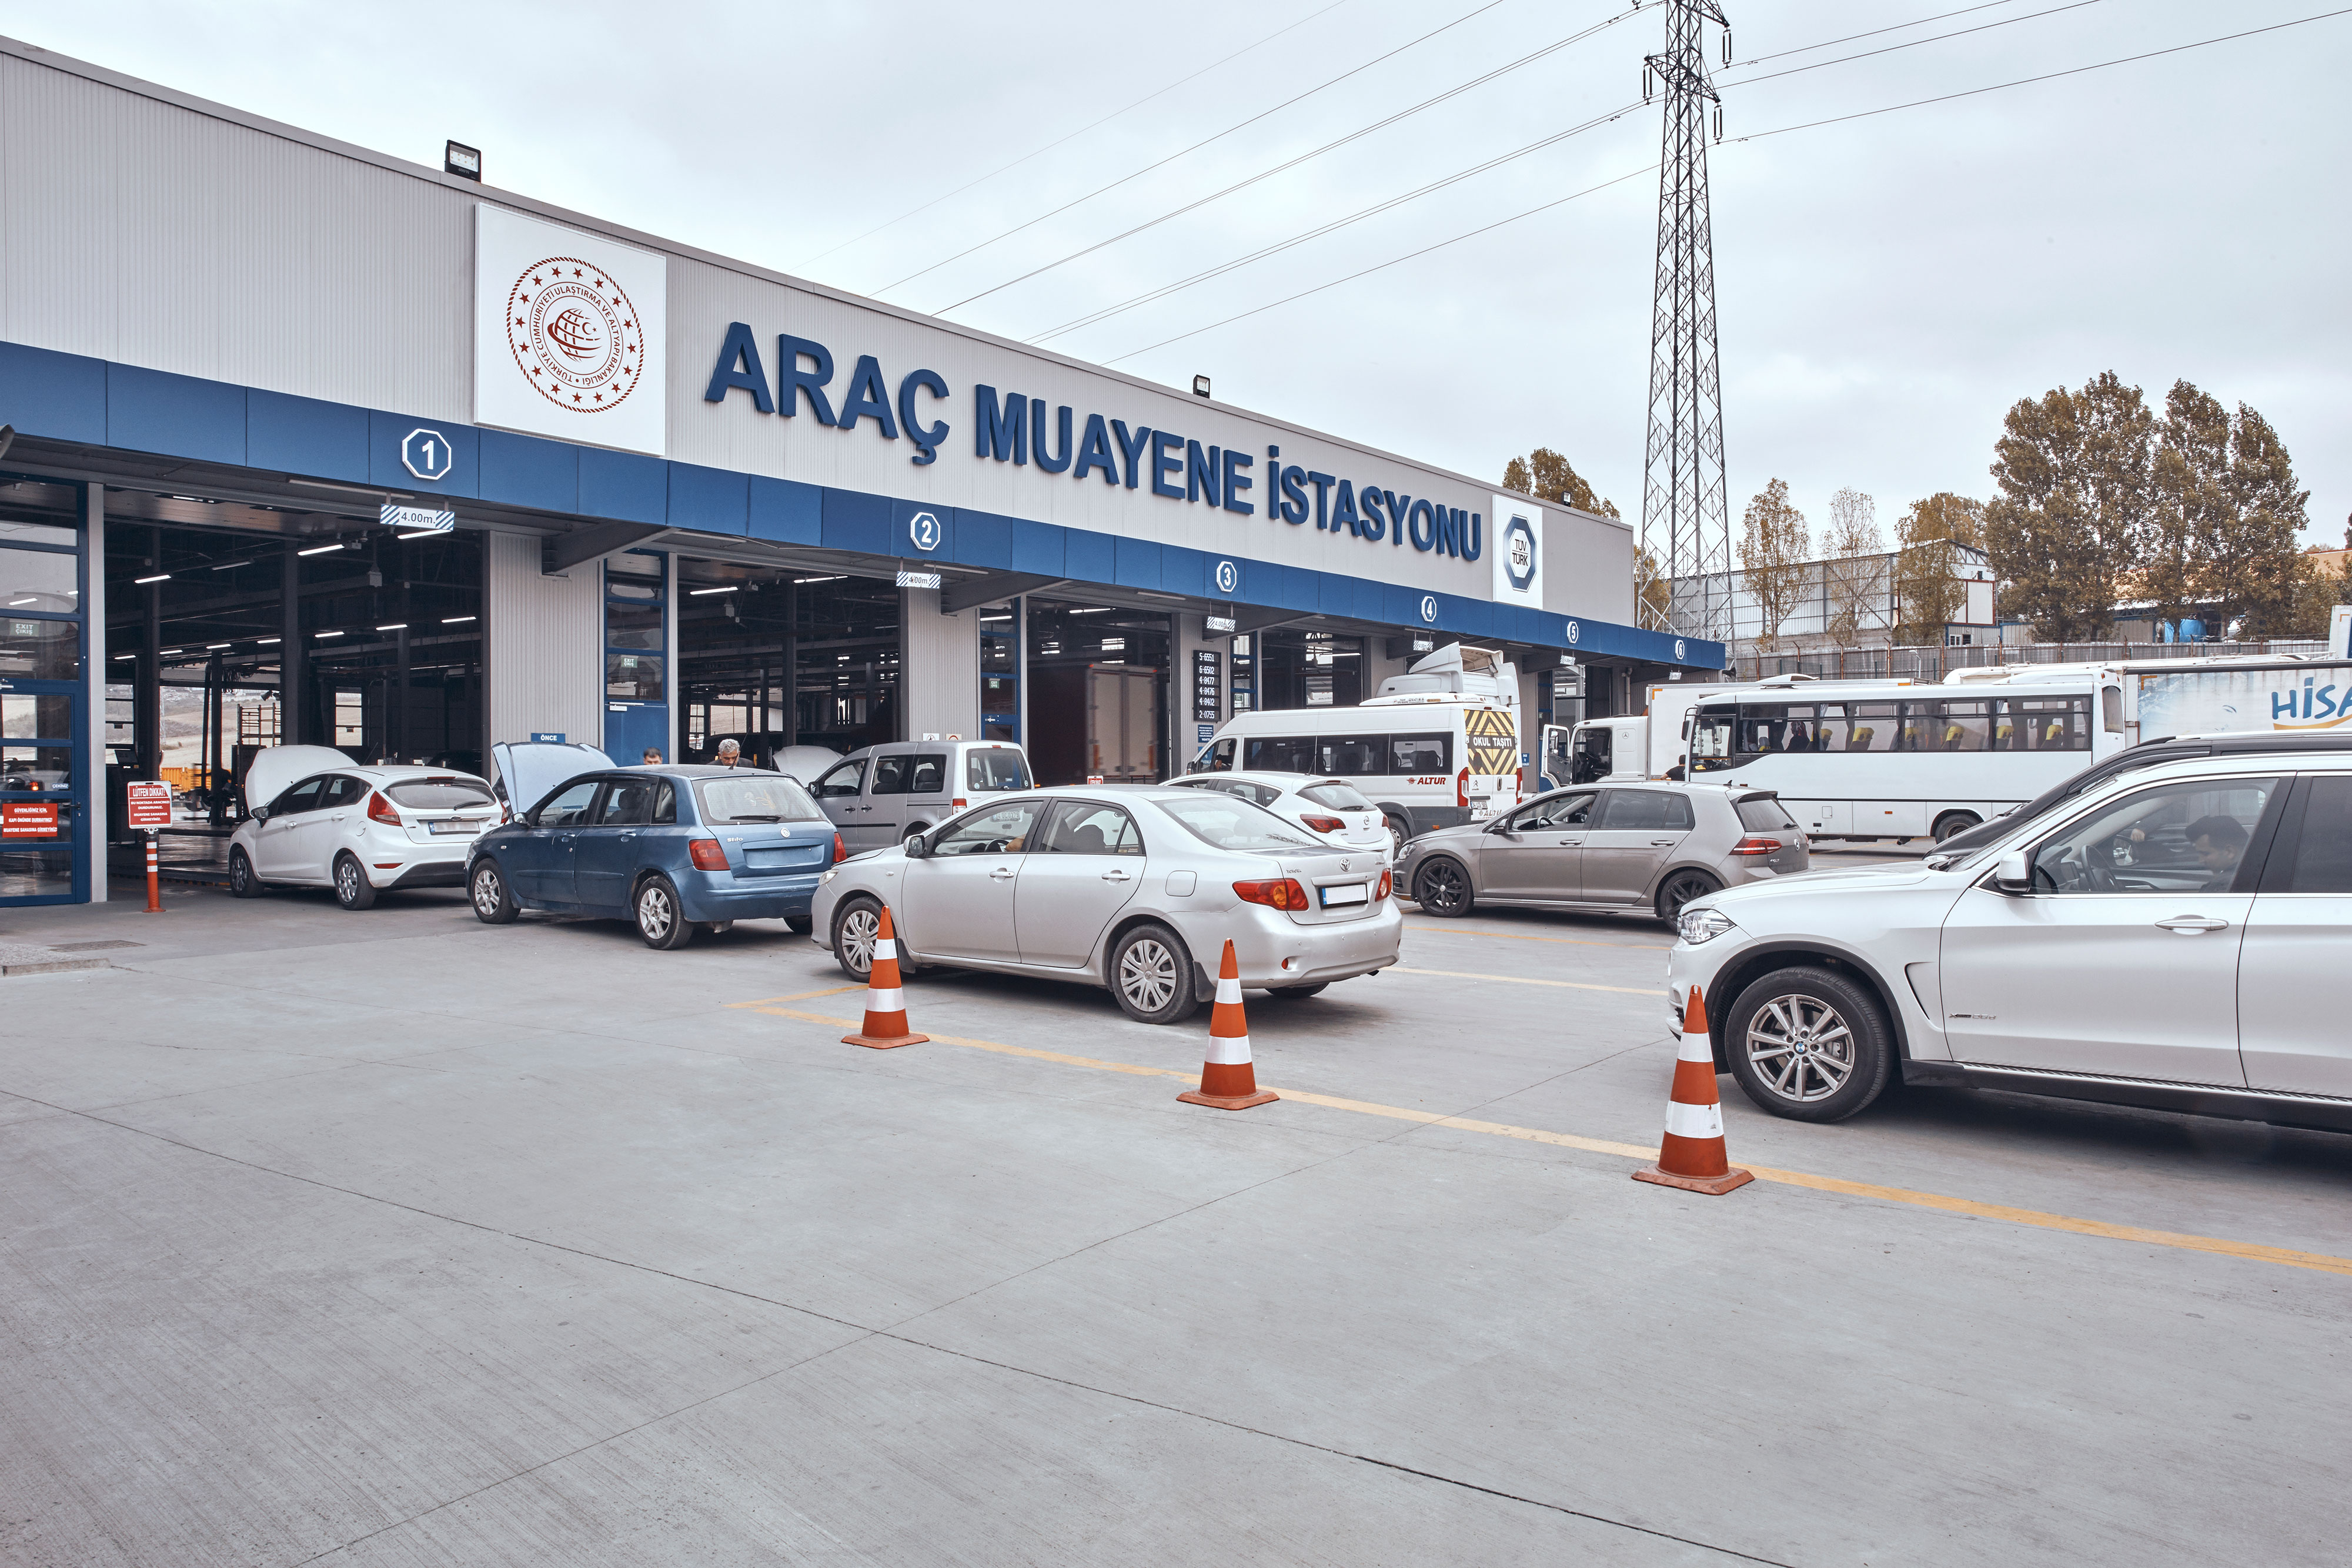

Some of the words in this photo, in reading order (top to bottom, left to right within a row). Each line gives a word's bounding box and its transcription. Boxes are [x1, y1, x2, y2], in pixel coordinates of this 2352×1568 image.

[554, 286, 601, 307] ULAŞTIRMA
[602, 305, 612, 318] VE
[533, 289, 554, 350] CUMHURİYETİ
[609, 319, 620, 356] ALTYAPI
[540, 351, 572, 382] TÜRKİYE
[582, 356, 617, 386] BAKANLIĞI
[704, 322, 950, 465] ARAÇ
[975, 384, 1254, 515] MUAYENE
[1268, 445, 1481, 561] İSTASYONU
[422, 440, 434, 470] 1
[401, 511, 436, 524] 4.00m.
[921, 520, 932, 543] 2
[1515, 539, 1527, 551] TÜV
[1512, 552, 1528, 567] TÜRK
[1224, 567, 1231, 586] 3
[1426, 601, 1433, 617] 4
[1571, 626, 1576, 640] 5
[1679, 643, 1683, 656] 6
[1199, 653, 1215, 662] 5-6551
[1199, 676, 1215, 685] 4-8477
[1199, 710, 1215, 719] 2-0755
[1473, 737, 1491, 747] OKUL
[1492, 737, 1512, 749] TAŞITI
[133, 786, 149, 797] LÜTFEN
[149, 785, 165, 797] DİKKAT!
